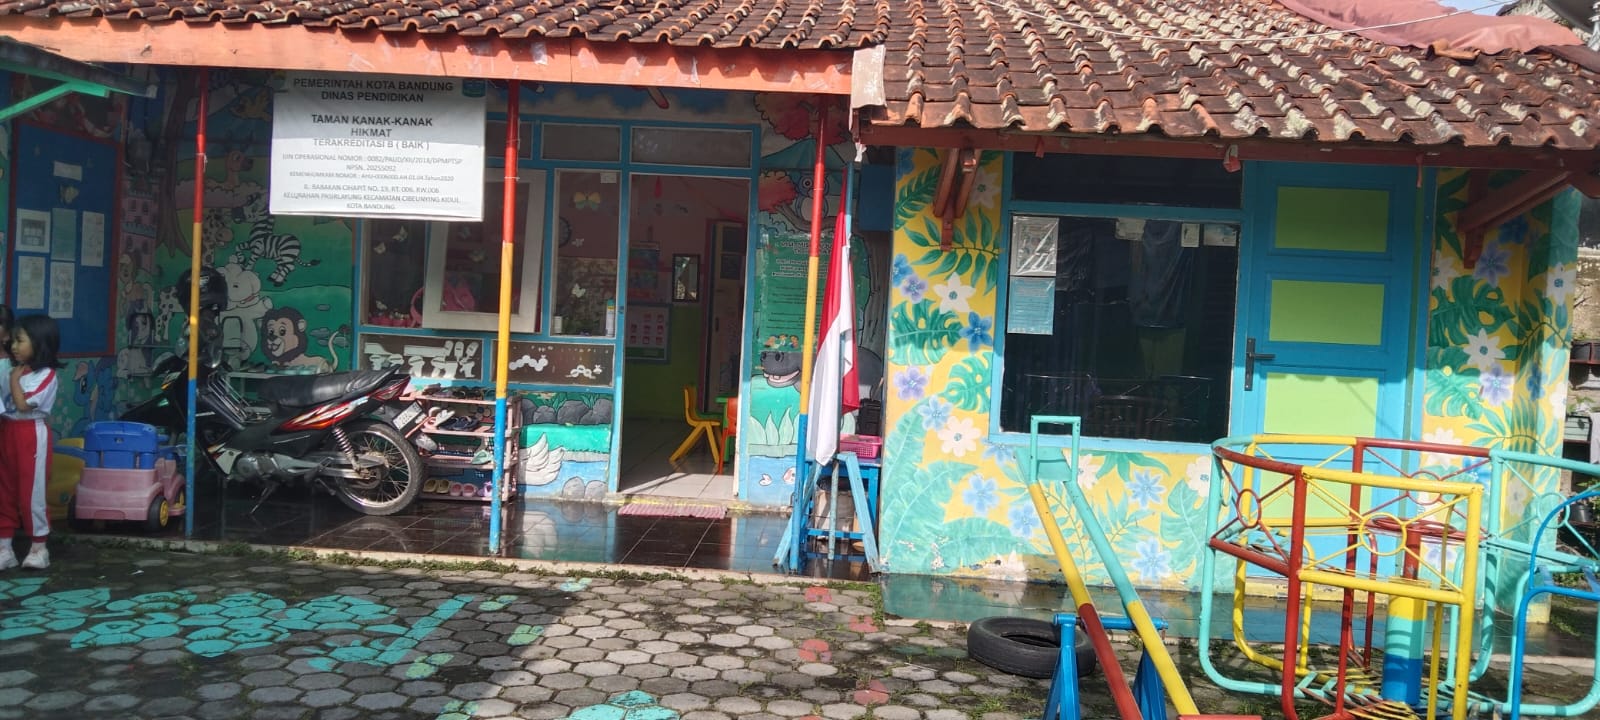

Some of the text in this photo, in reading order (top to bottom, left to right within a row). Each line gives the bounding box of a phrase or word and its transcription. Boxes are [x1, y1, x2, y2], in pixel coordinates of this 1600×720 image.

[293, 78, 362, 89] PEMERINTAH
[366, 80, 395, 90] KOTA
[398, 81, 454, 91] BANDUNG
[321, 91, 424, 103] DINAS PENDIDIKAN
[312, 114, 433, 126] TAMAN KANAK-KANAK
[351, 128, 392, 137] HIKMAT
[314, 138, 385, 148] TERAKREDITASI
[387, 140, 394, 148] B
[401, 141, 425, 149] BAIK
[294, 153, 336, 161] OPERASIONAL
[283, 192, 320, 200] KELURAHAN
[363, 194, 401, 202] KECAMATAN
[401, 195, 440, 203] CIBEUNYING
